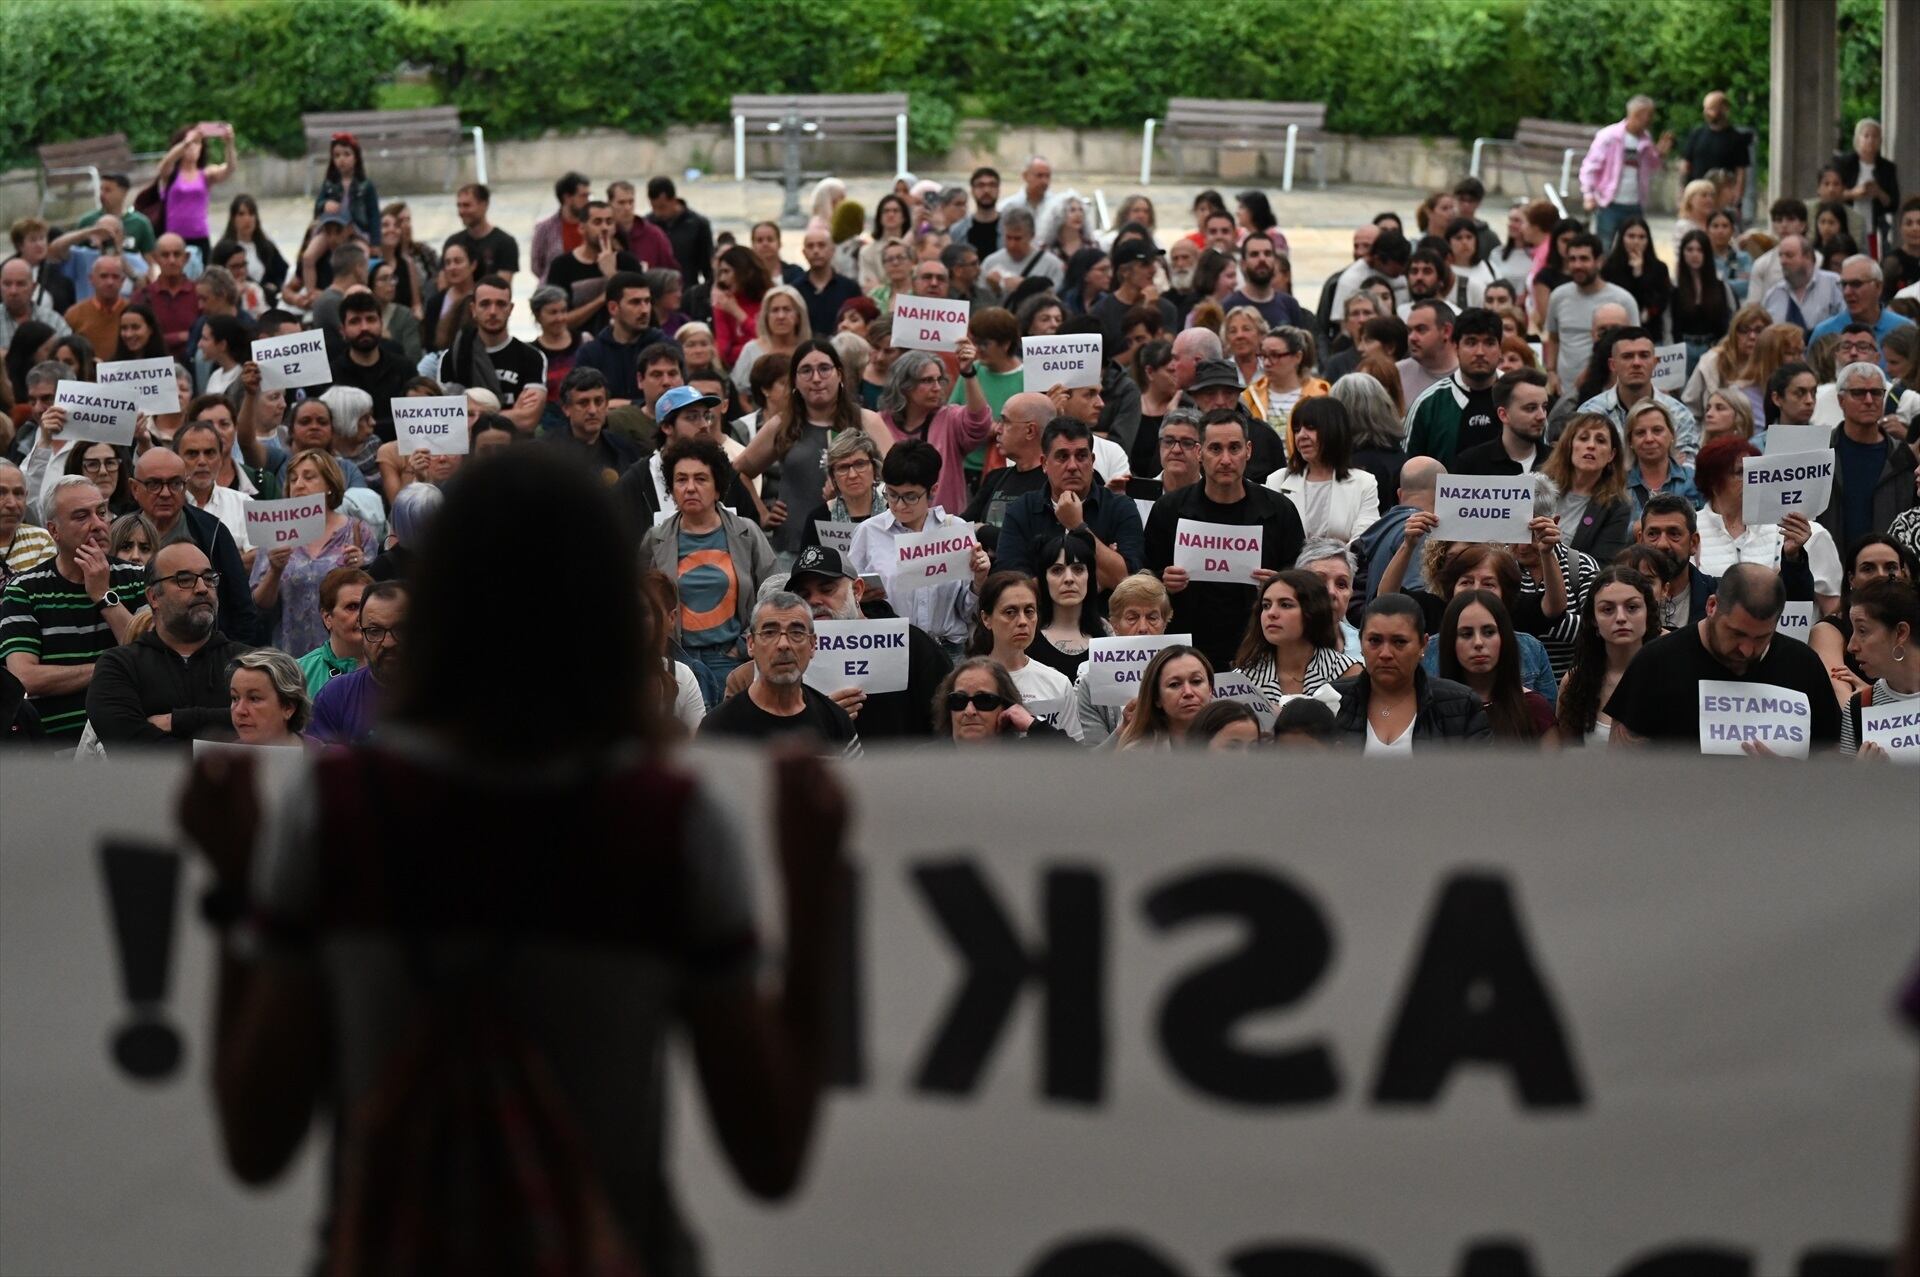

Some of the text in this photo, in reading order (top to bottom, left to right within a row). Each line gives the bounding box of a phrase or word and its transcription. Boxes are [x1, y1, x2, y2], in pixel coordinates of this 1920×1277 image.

[897, 306, 966, 324] NAHIKOA
[919, 329, 941, 342] DA
[256, 340, 323, 361] ERASORIK
[1026, 343, 1100, 356] NAZKATUTA
[284, 362, 301, 376] EZ
[1042, 360, 1084, 371] GAUDE
[100, 367, 173, 383] NAZKATUTA
[58, 393, 136, 412] NAZKATUTA
[72, 411, 118, 425] GAUDE
[394, 407, 465, 419] NAZKATUTA
[408, 424, 449, 435] GAUDE
[1748, 462, 1832, 484] ERASORIK
[1440, 487, 1531, 500] NAZKATUTA
[1781, 490, 1802, 505] EZ
[247, 504, 323, 522] NAHIKOA
[1458, 507, 1511, 519] GAUDE
[275, 528, 299, 542] DA
[1178, 532, 1259, 551] NAHIKOA
[900, 535, 974, 561] NAHIKOA
[925, 563, 948, 577] DA
[1205, 558, 1230, 572] DA
[1093, 649, 1161, 662] NAZKAT
[844, 660, 869, 676] EZ
[1212, 684, 1256, 699] NAZKA
[1704, 696, 1808, 716] ESTAMOS
[1867, 712, 1920, 731] NAZKA
[1710, 724, 1803, 742] HARTAS
